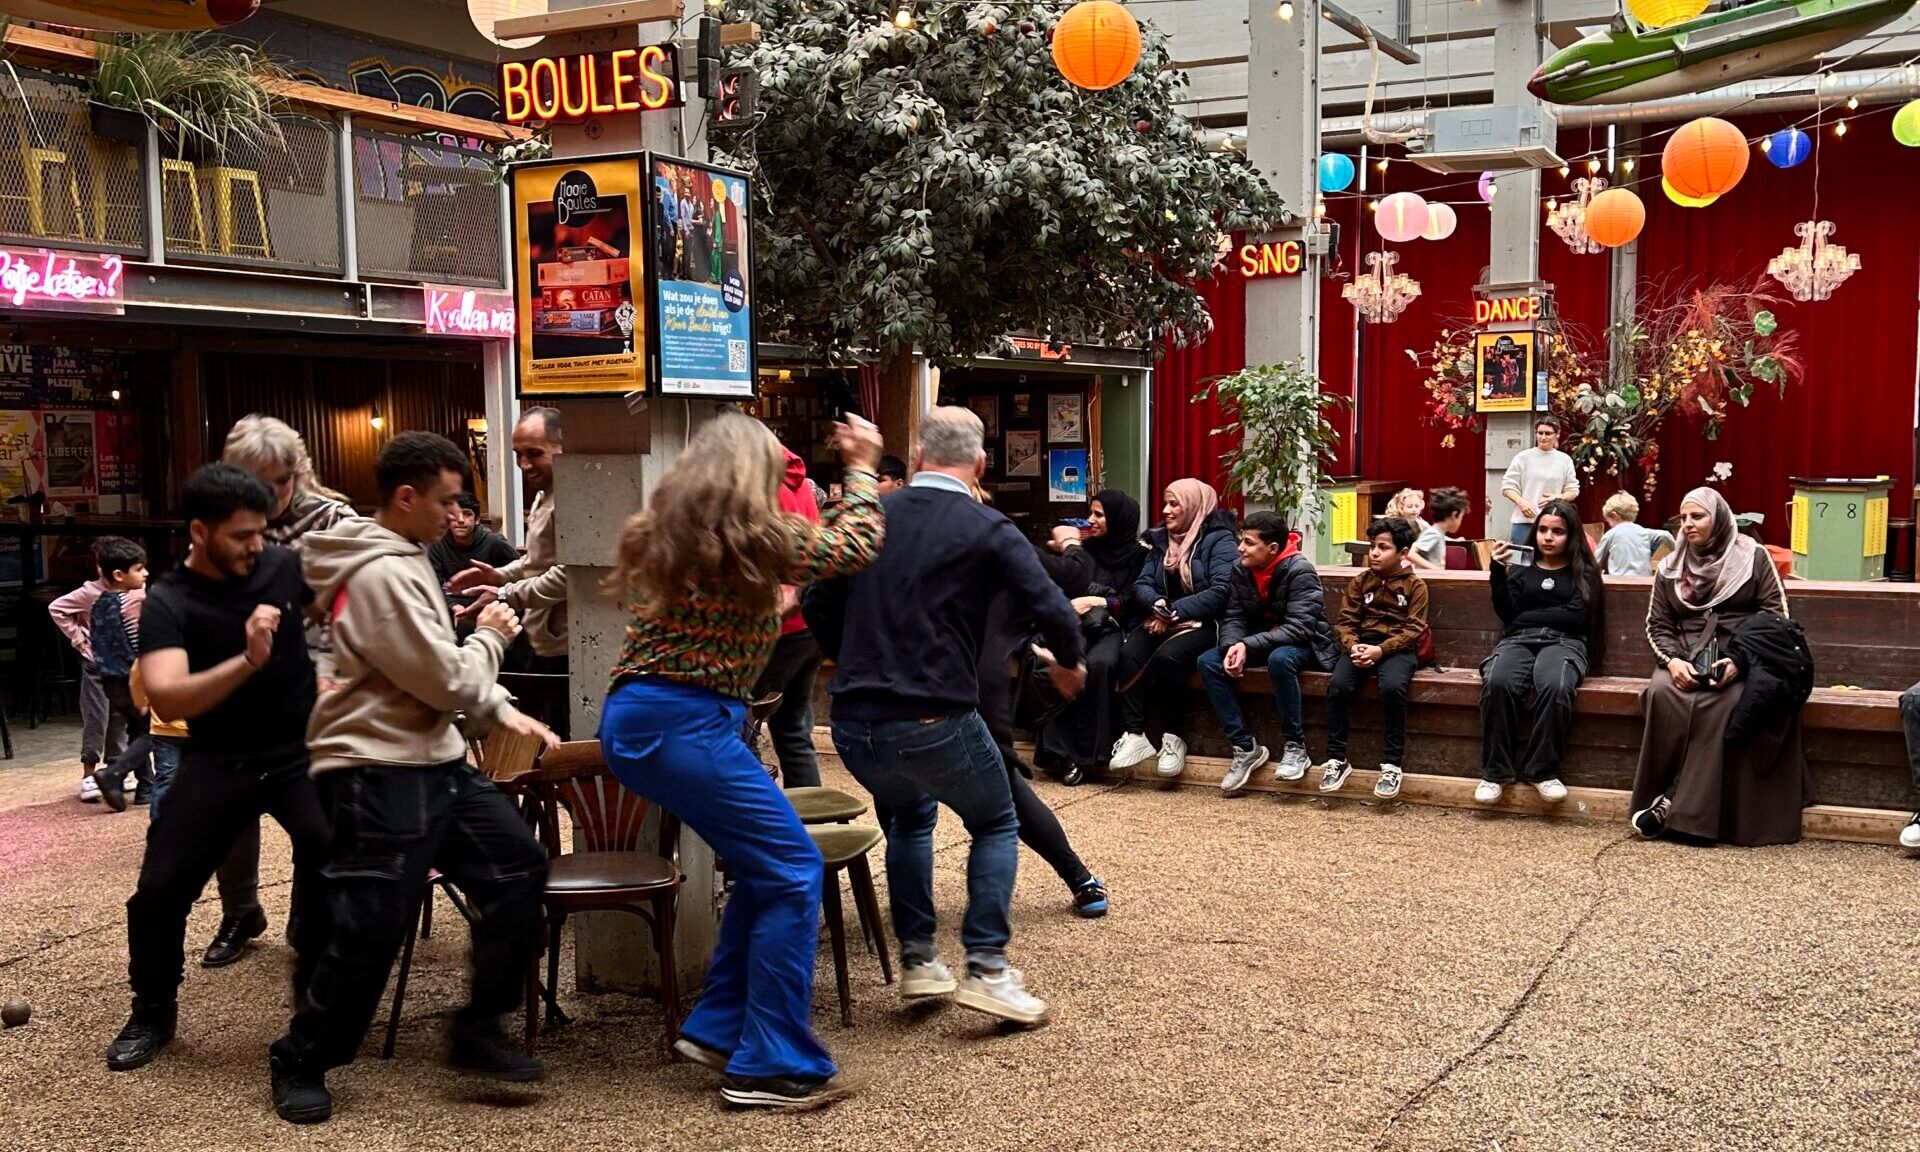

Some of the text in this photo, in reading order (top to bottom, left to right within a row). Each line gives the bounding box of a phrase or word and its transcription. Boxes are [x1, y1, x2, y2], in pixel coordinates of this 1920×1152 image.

[503, 46, 669, 121] BOULES
[558, 197, 597, 225] Boules
[582, 289, 612, 302] CATAN
[663, 290, 718, 306] Wat zou je doen
[664, 303, 676, 314] als
[676, 304, 685, 317] je
[685, 304, 695, 316] de
[1475, 296, 1542, 322] DANCE
[52, 358, 77, 369] JAAR
[1816, 502, 1857, 519] 7 8
